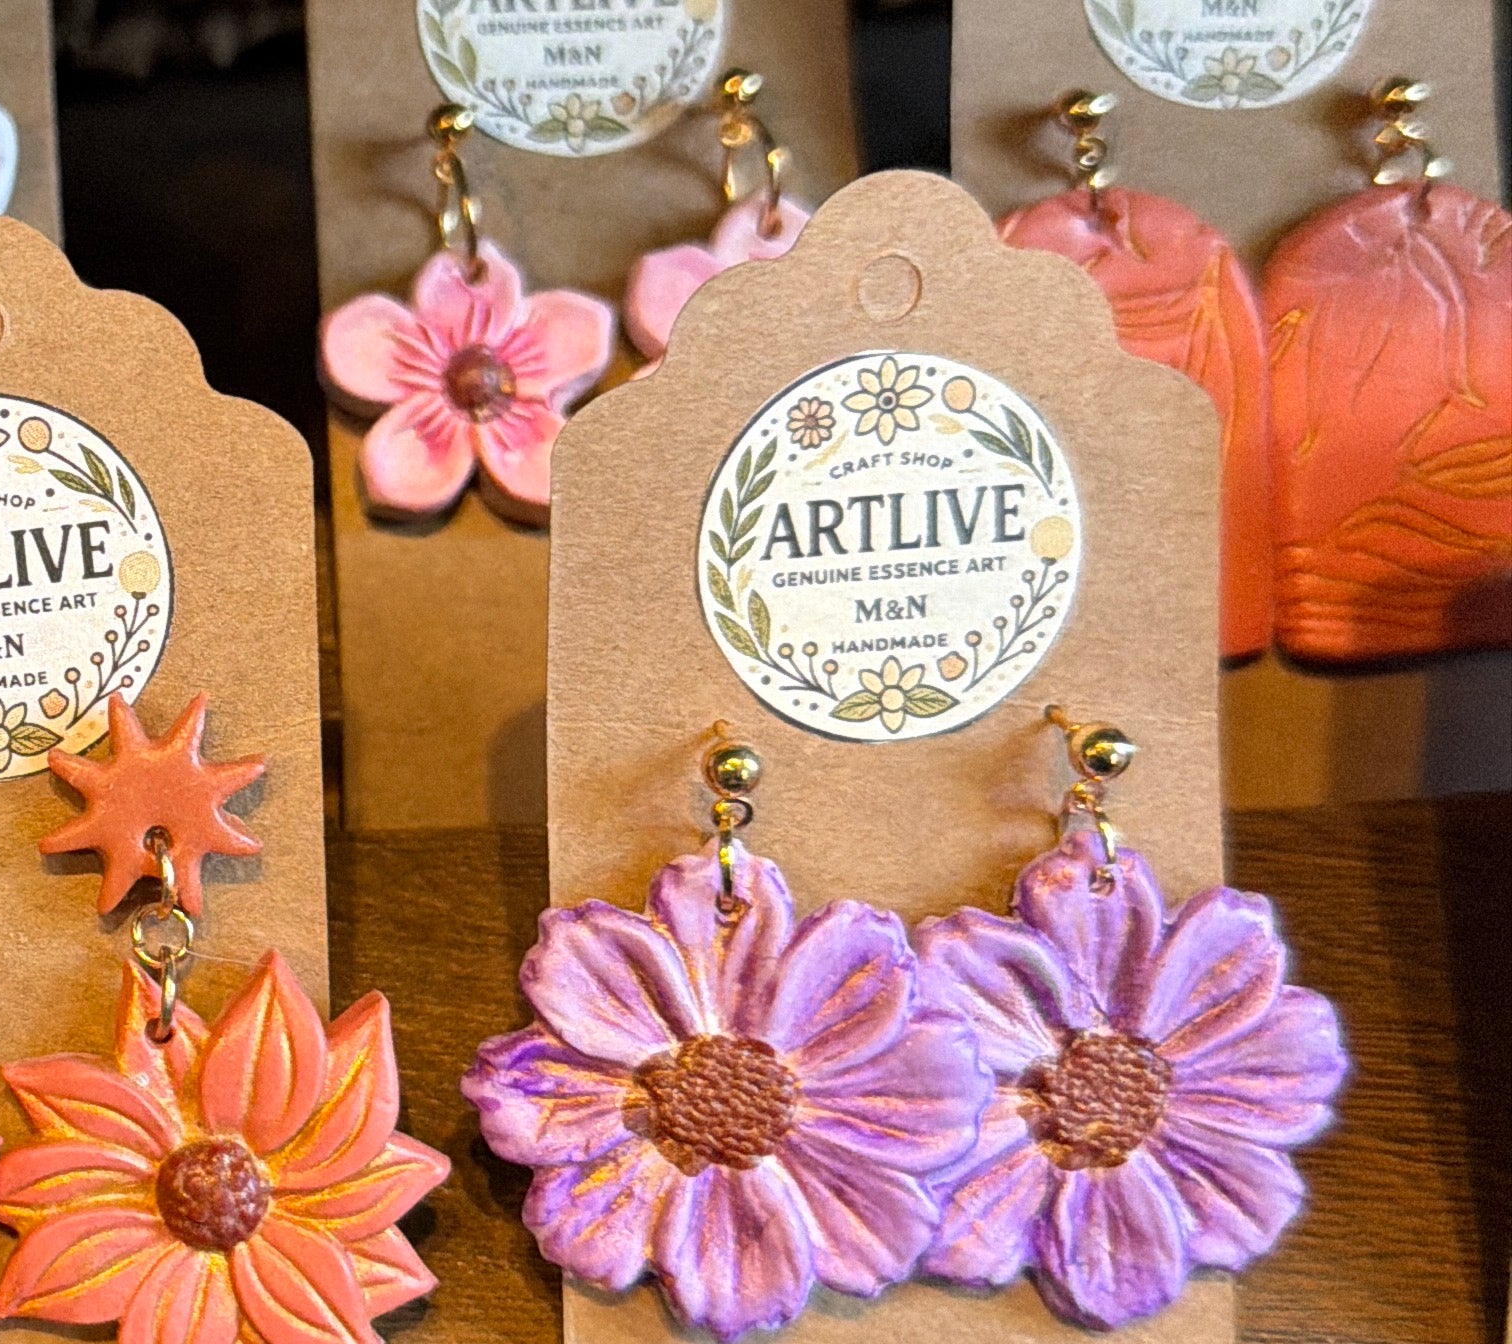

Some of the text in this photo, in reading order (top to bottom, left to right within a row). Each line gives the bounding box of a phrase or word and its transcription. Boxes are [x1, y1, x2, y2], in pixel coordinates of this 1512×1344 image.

[554, 18, 627, 33] ESSENCE
[633, 16, 664, 30] ART
[829, 451, 953, 479] CRAFT SHOP
[760, 483, 1026, 561] ARTLIVE
[772, 557, 1007, 588] GENUINE ESSENCE ART
[59, 592, 98, 609] ART
[855, 594, 928, 623] M&N
[832, 634, 949, 655] HANDMADE
